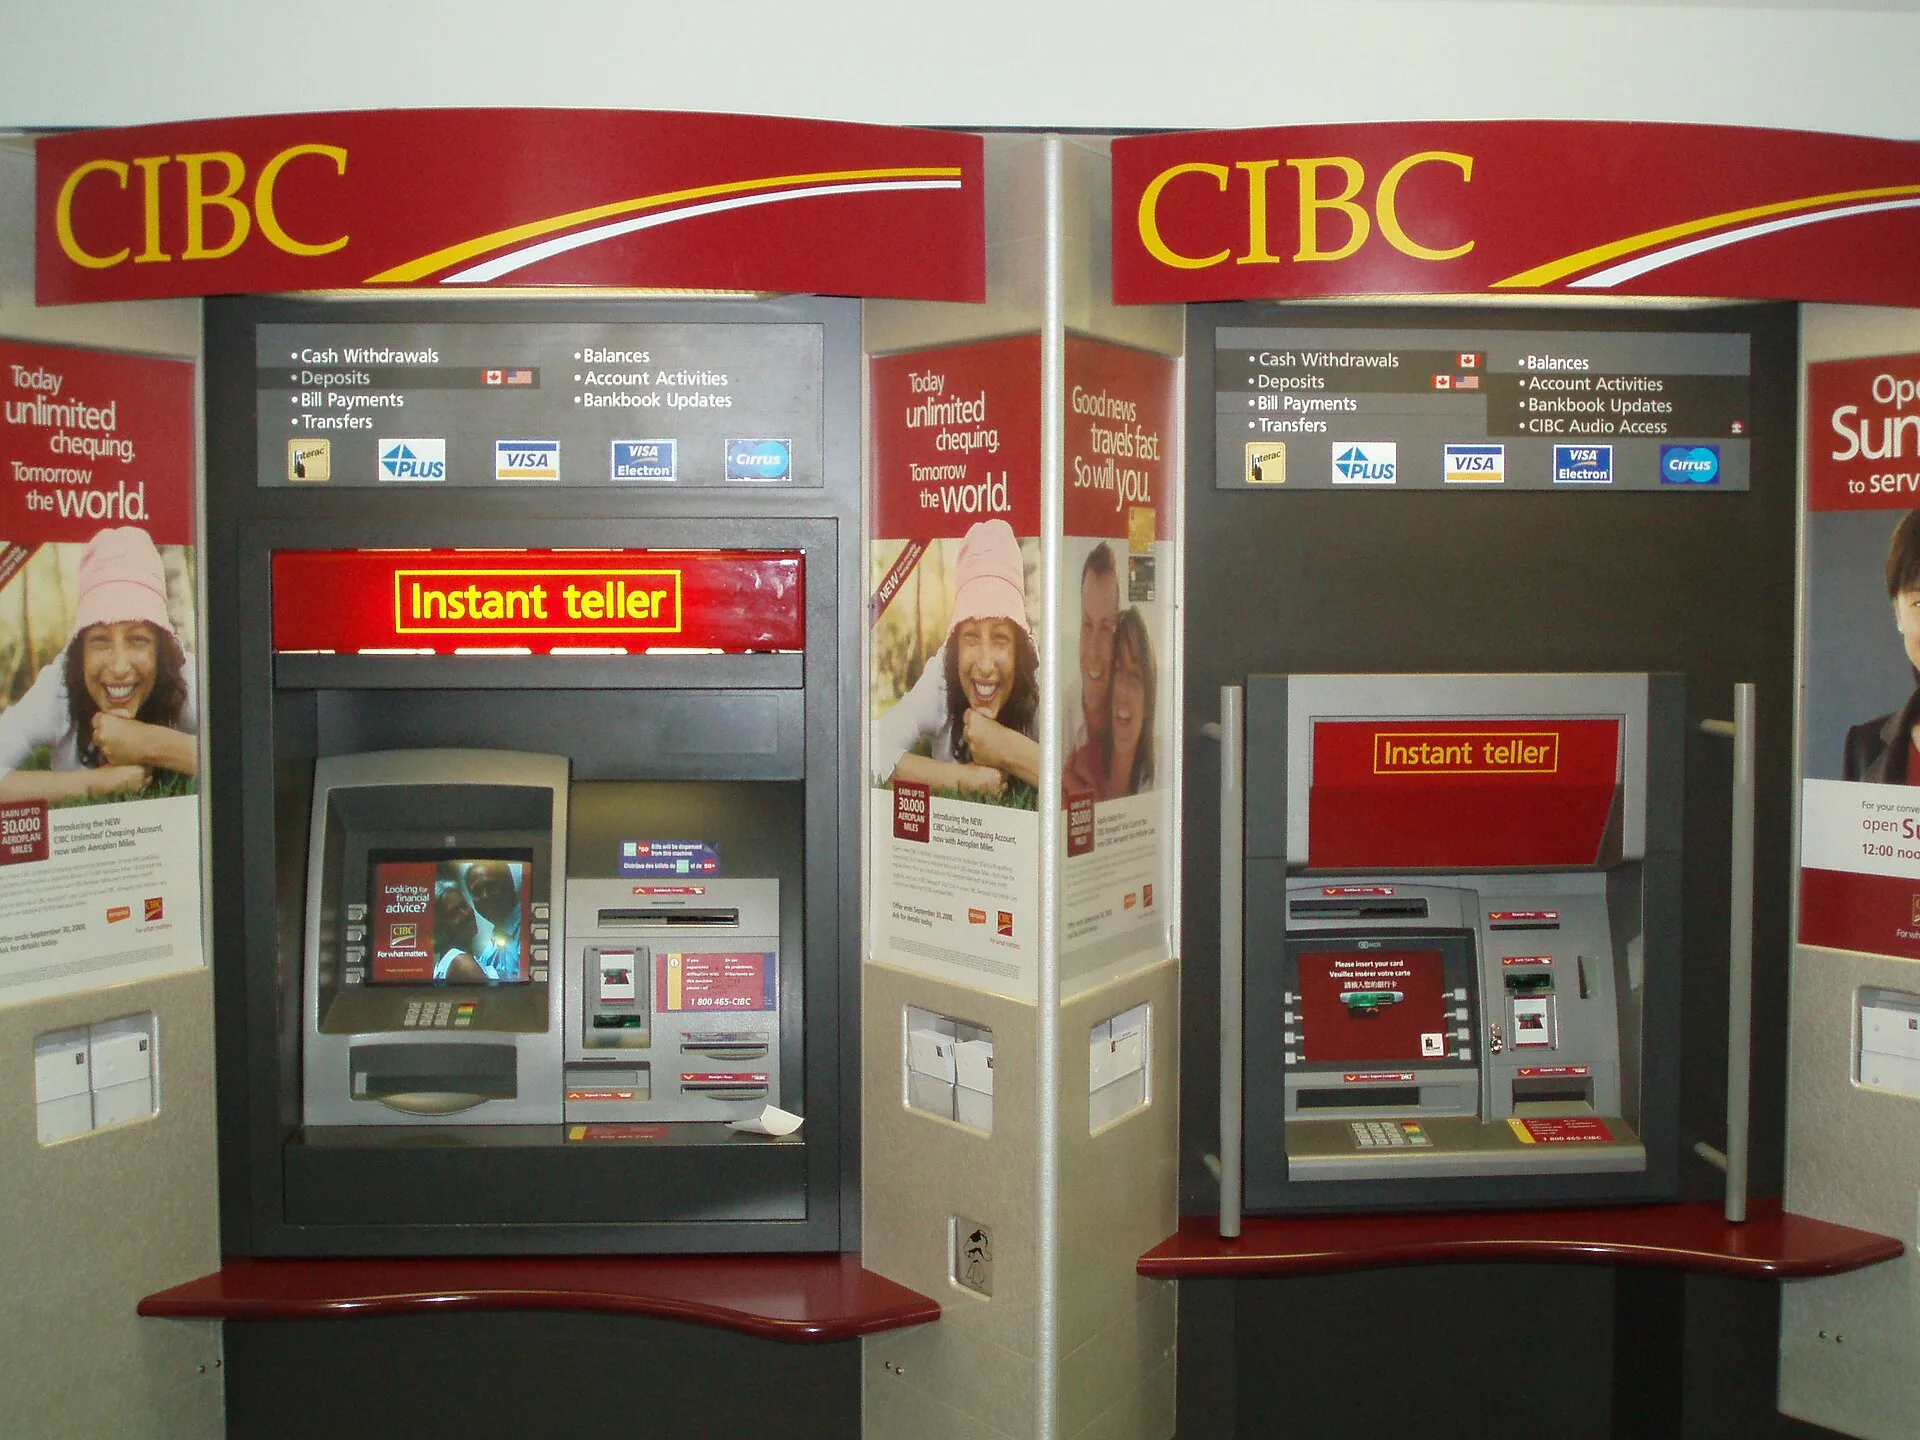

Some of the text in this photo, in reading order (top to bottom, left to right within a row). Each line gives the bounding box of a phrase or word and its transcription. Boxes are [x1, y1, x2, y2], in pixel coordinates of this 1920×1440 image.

[55, 143, 349, 269] CIBC
[1137, 151, 1477, 269] CIBC
[302, 348, 439, 364] Cash Withdrawals
[584, 349, 650, 363] Balances
[1260, 352, 1399, 368] Cash Withdrawals
[1527, 355, 1589, 370] Balances
[10, 365, 63, 396] Today
[302, 371, 370, 388] Deposits
[585, 370, 728, 385] Account Activities
[908, 370, 945, 396] Today
[1258, 374, 1325, 392] Deposits
[1529, 377, 1663, 392] Account Activities
[302, 393, 404, 410] Bill Payments
[584, 392, 732, 411] Bankbook Updates
[906, 390, 985, 428] unlimited
[1072, 385, 1136, 422] Good news
[1258, 395, 1357, 414] Bill Payments
[1529, 398, 1672, 415] Bankbook Updates
[6, 395, 116, 431] unlimited
[302, 414, 373, 429] Transfers
[1259, 417, 1327, 433] Transfers
[1529, 419, 1667, 434] CIBC Audio Access
[50, 430, 136, 464] chequing.
[936, 425, 1000, 454] chequing.
[1091, 422, 1134, 457] travels
[628, 445, 659, 457] VISA
[1569, 450, 1598, 461] VISA
[507, 453, 549, 467] VISA
[736, 452, 782, 466] Cirrus
[1455, 457, 1494, 470] VISA
[1669, 459, 1712, 471] Cirrus
[11, 461, 92, 484] Tomorrow
[397, 461, 444, 478] PLUS
[618, 464, 670, 477] Electron
[909, 463, 967, 481] Tomorrow
[1351, 464, 1395, 479] PLUS
[1559, 468, 1608, 480] Electron
[1074, 455, 1151, 512] So will you.
[1848, 473, 1920, 493] to serv
[920, 471, 1011, 513] the world.
[26, 480, 149, 520] the world.
[880, 572, 899, 603] NEW
[412, 582, 667, 620] Instant teller
[1385, 740, 1550, 765] Instant teller
[21, 808, 30, 816] UP
[31, 807, 40, 815] TO
[1862, 801, 1874, 810] For
[1876, 803, 1895, 812] your
[54, 817, 121, 833] Introducing the NEW
[933, 812, 960, 825] Introducing
[970, 817, 982, 826] NEW
[1862, 819, 1898, 834] open
[903, 822, 919, 832] MILES
[71, 845, 87, 854] with
[88, 841, 117, 852] Aeroplan
[945, 837, 956, 845] with
[957, 839, 979, 849] Aeroplan
[1862, 844, 1893, 857] 12:00
[385, 885, 418, 895] Looking
[396, 893, 430, 902] financial
[386, 902, 427, 913] advice?
[913, 906, 936, 917] September
[30, 926, 62, 939] September
[393, 926, 414, 935] CIBC
[377, 950, 388, 958] For
[388, 950, 403, 958] what
[1335, 960, 1355, 968] Please
[691, 997, 752, 1006] 1 800 465-CIBC
